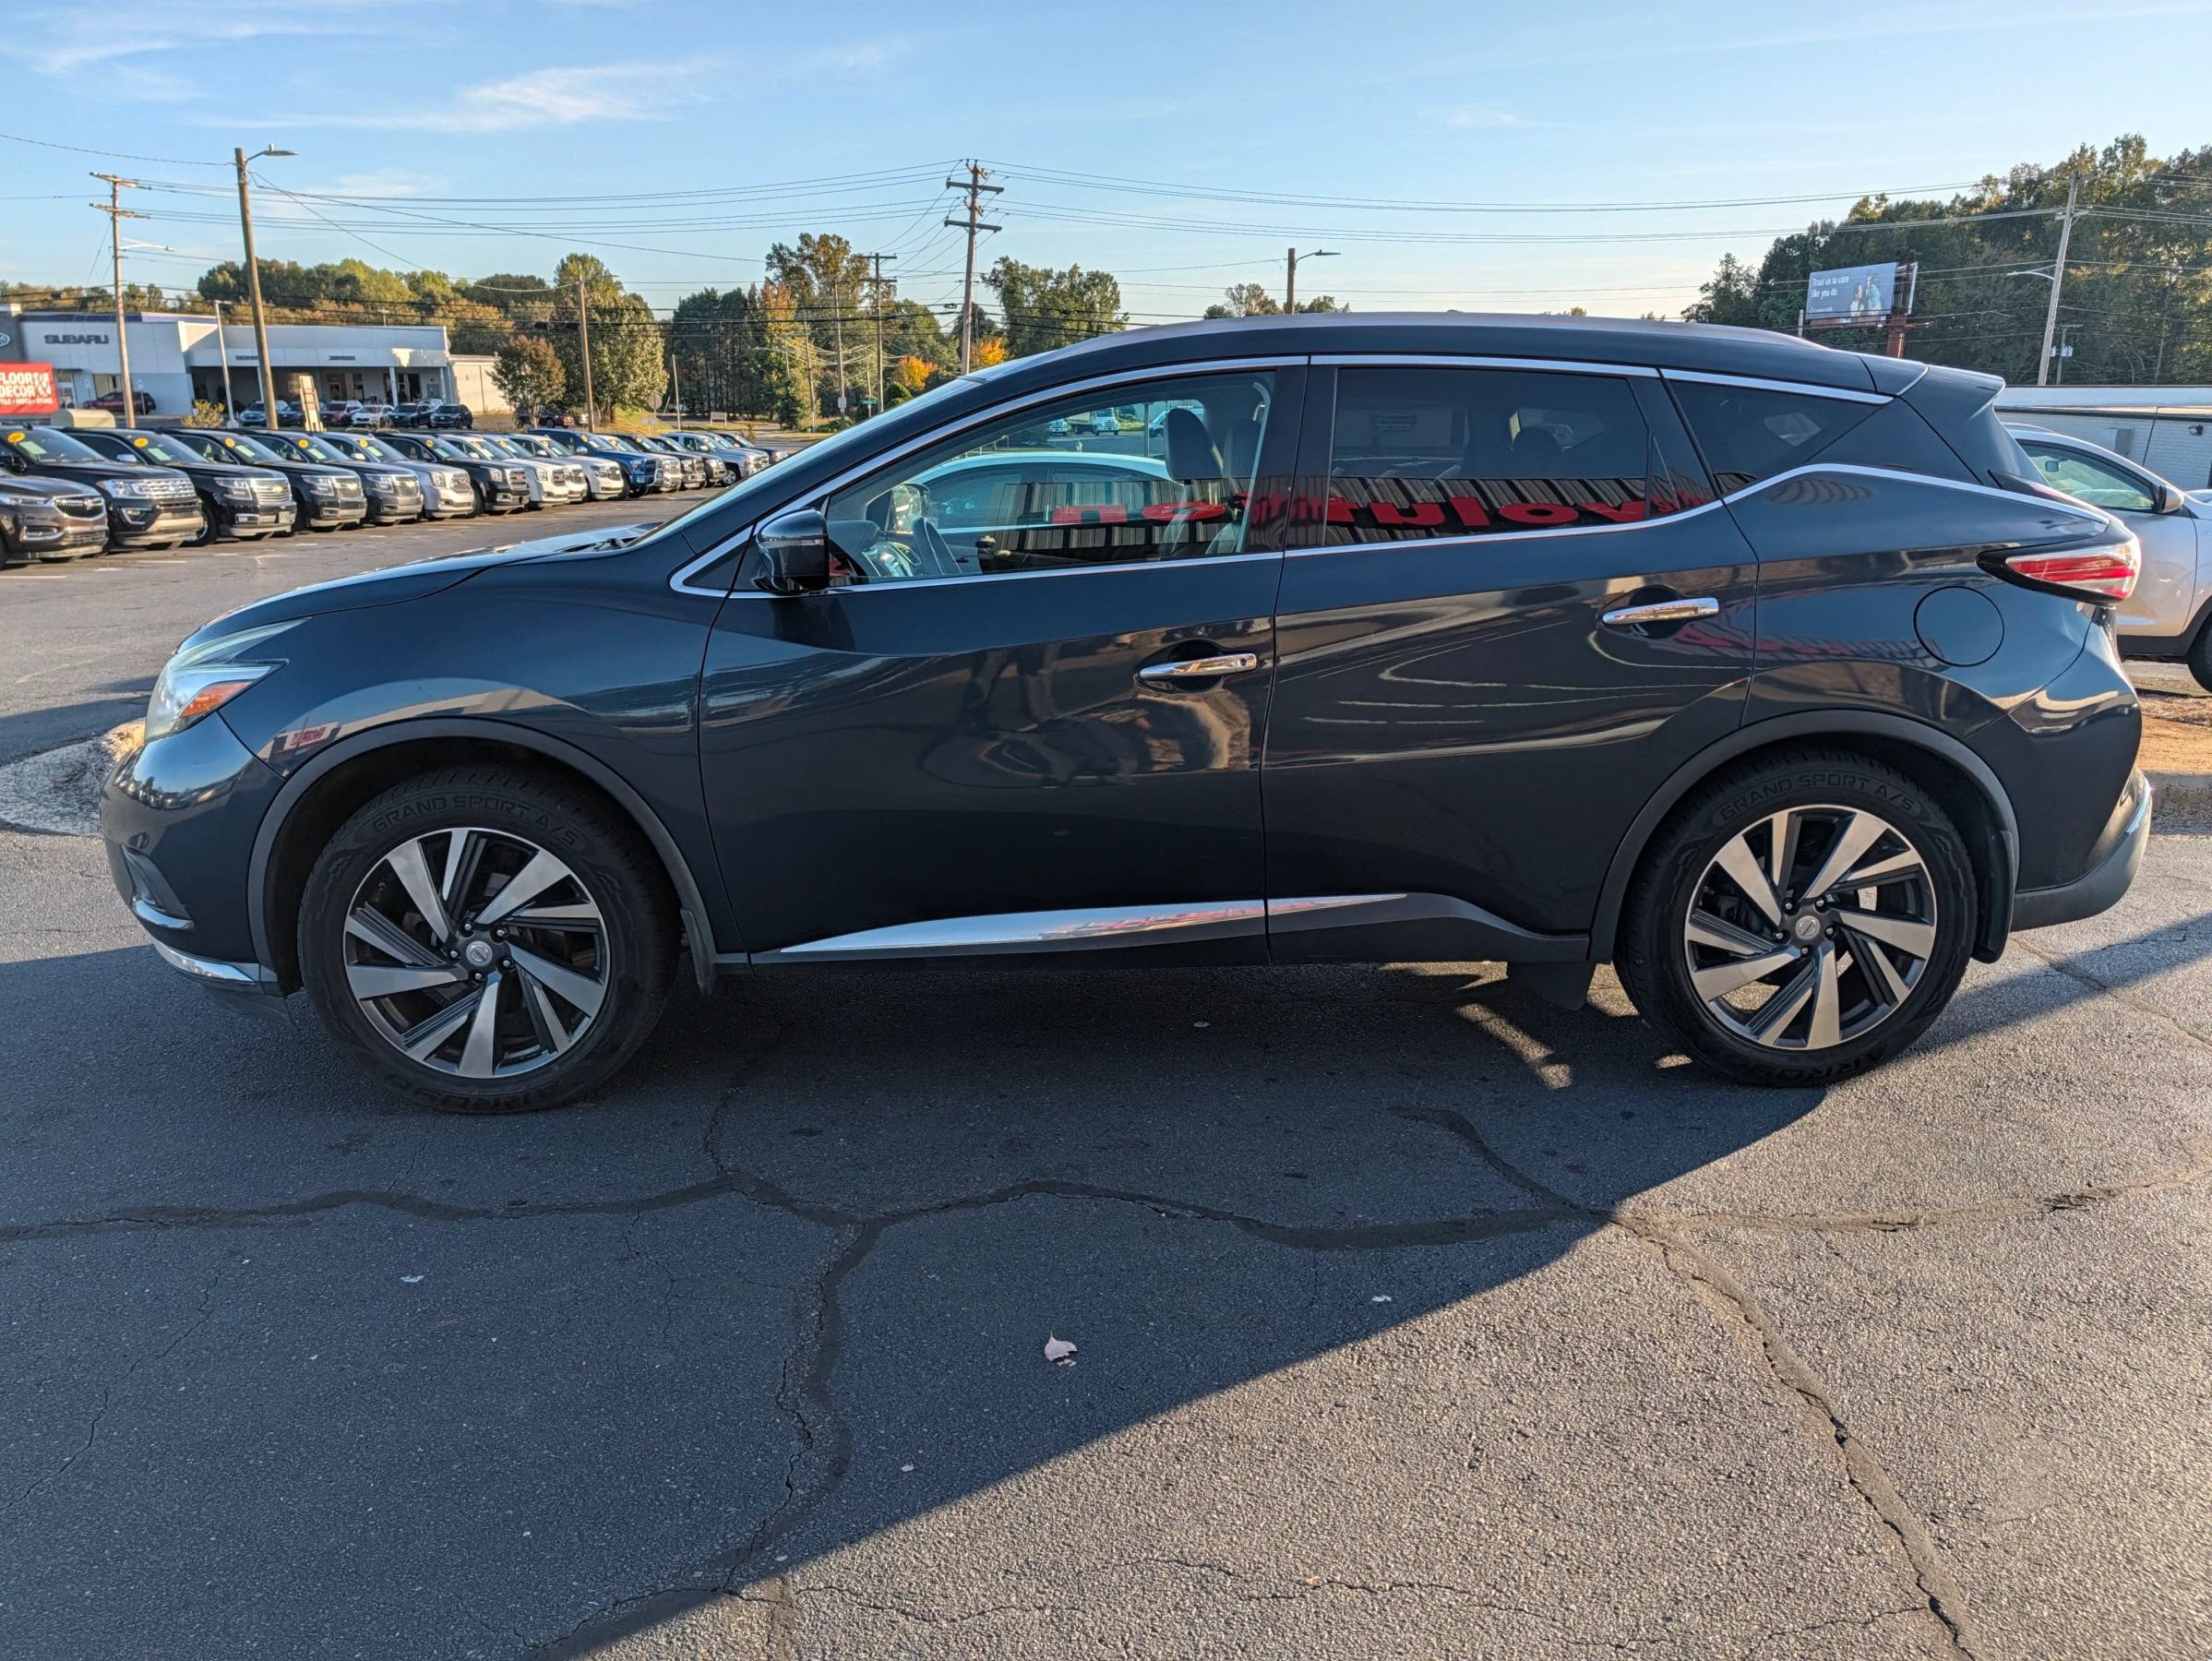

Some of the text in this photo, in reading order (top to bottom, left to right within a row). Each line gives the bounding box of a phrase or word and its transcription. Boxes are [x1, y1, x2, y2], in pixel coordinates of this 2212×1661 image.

[43, 334, 110, 344] SUBARU
[0, 385, 36, 398] DECOR
[1720, 773, 1915, 820] GRAND SPORT A/S
[372, 795, 580, 846] GRAND SPORT A/S
